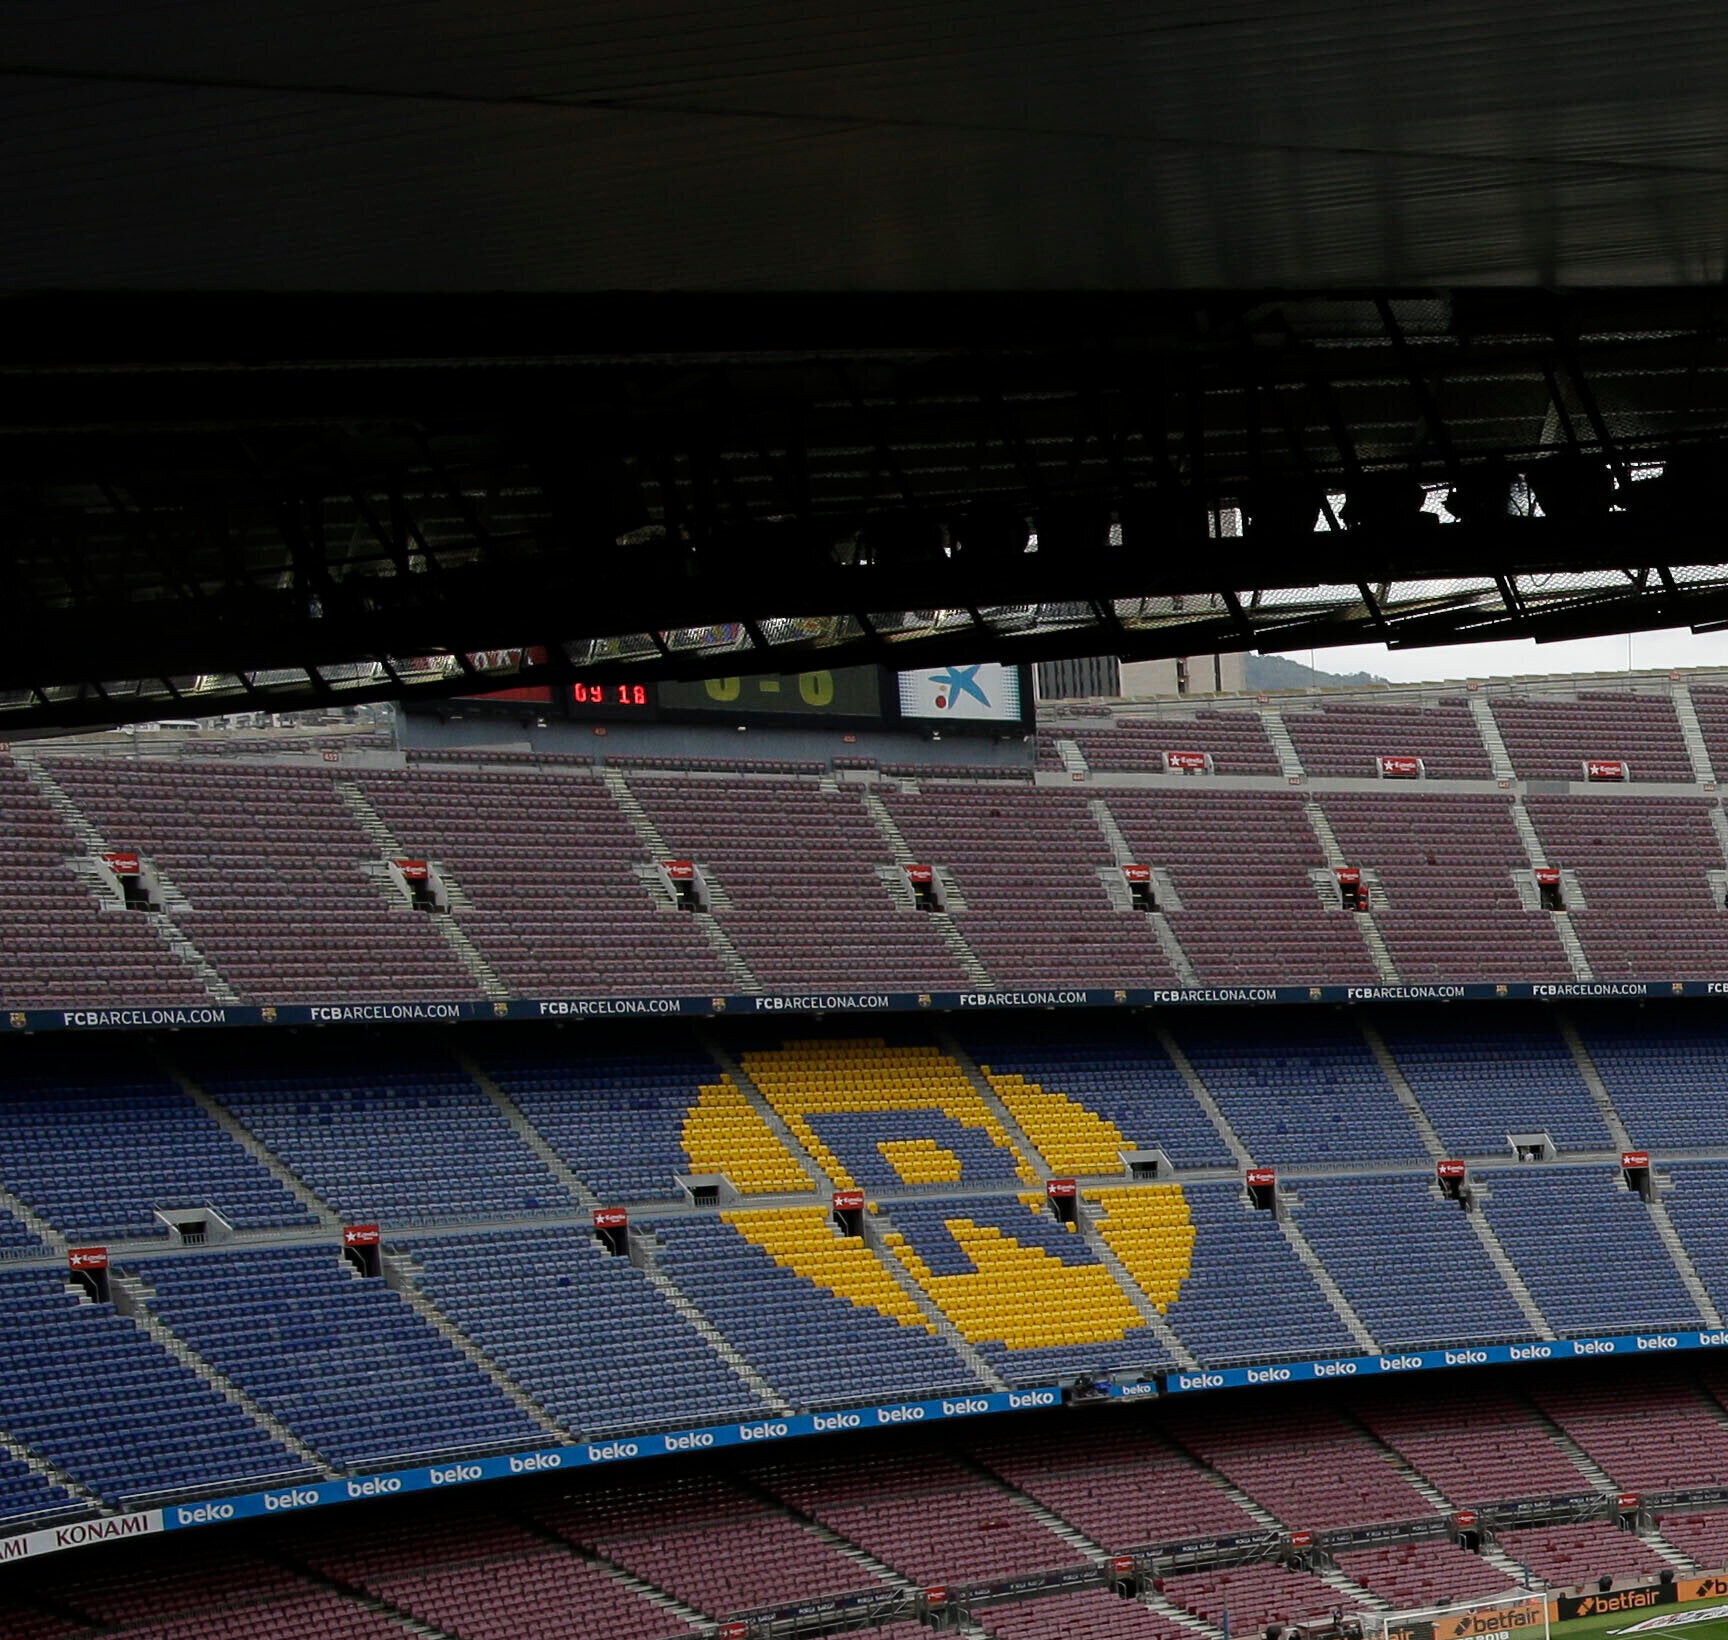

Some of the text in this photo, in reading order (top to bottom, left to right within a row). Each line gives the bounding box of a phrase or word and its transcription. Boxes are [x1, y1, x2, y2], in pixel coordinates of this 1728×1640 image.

[959, 992, 1087, 1005] FCBARCELONA.COM
[1154, 989, 1276, 1001] FCBARCELONA.COM
[1348, 986, 1464, 998] FCBARCELONA.COM
[1533, 985, 1646, 996] FCBARCELONA.COM
[540, 1000, 680, 1014] FCBARCELONA.COM
[756, 996, 888, 1009] FCBARCELONA.COM
[63, 1009, 225, 1025] FCBARCELONA.COM
[311, 1005, 459, 1019] FCBARCELONA.COM
[1573, 1338, 1614, 1355] beko
[1637, 1334, 1677, 1350] beko
[1445, 1349, 1488, 1366] beko
[1510, 1343, 1551, 1360] beko
[1314, 1359, 1356, 1377] beko
[1380, 1354, 1422, 1371] beko
[1180, 1373, 1223, 1390] beko
[1247, 1367, 1291, 1384] beko
[1122, 1383, 1151, 1396] beko
[943, 1398, 988, 1416] beko
[1009, 1390, 1053, 1408] beko
[814, 1413, 860, 1432] beko
[878, 1405, 924, 1423] beko
[740, 1422, 787, 1441] beko
[665, 1432, 713, 1450] beko
[588, 1443, 638, 1462] beko
[510, 1453, 560, 1474] beko
[430, 1464, 482, 1486] beko
[347, 1474, 401, 1497] beko
[264, 1488, 319, 1511] beko
[178, 1502, 233, 1525] beko
[55, 1514, 149, 1546] KONAMI
[1596, 1589, 1659, 1614] betfair
